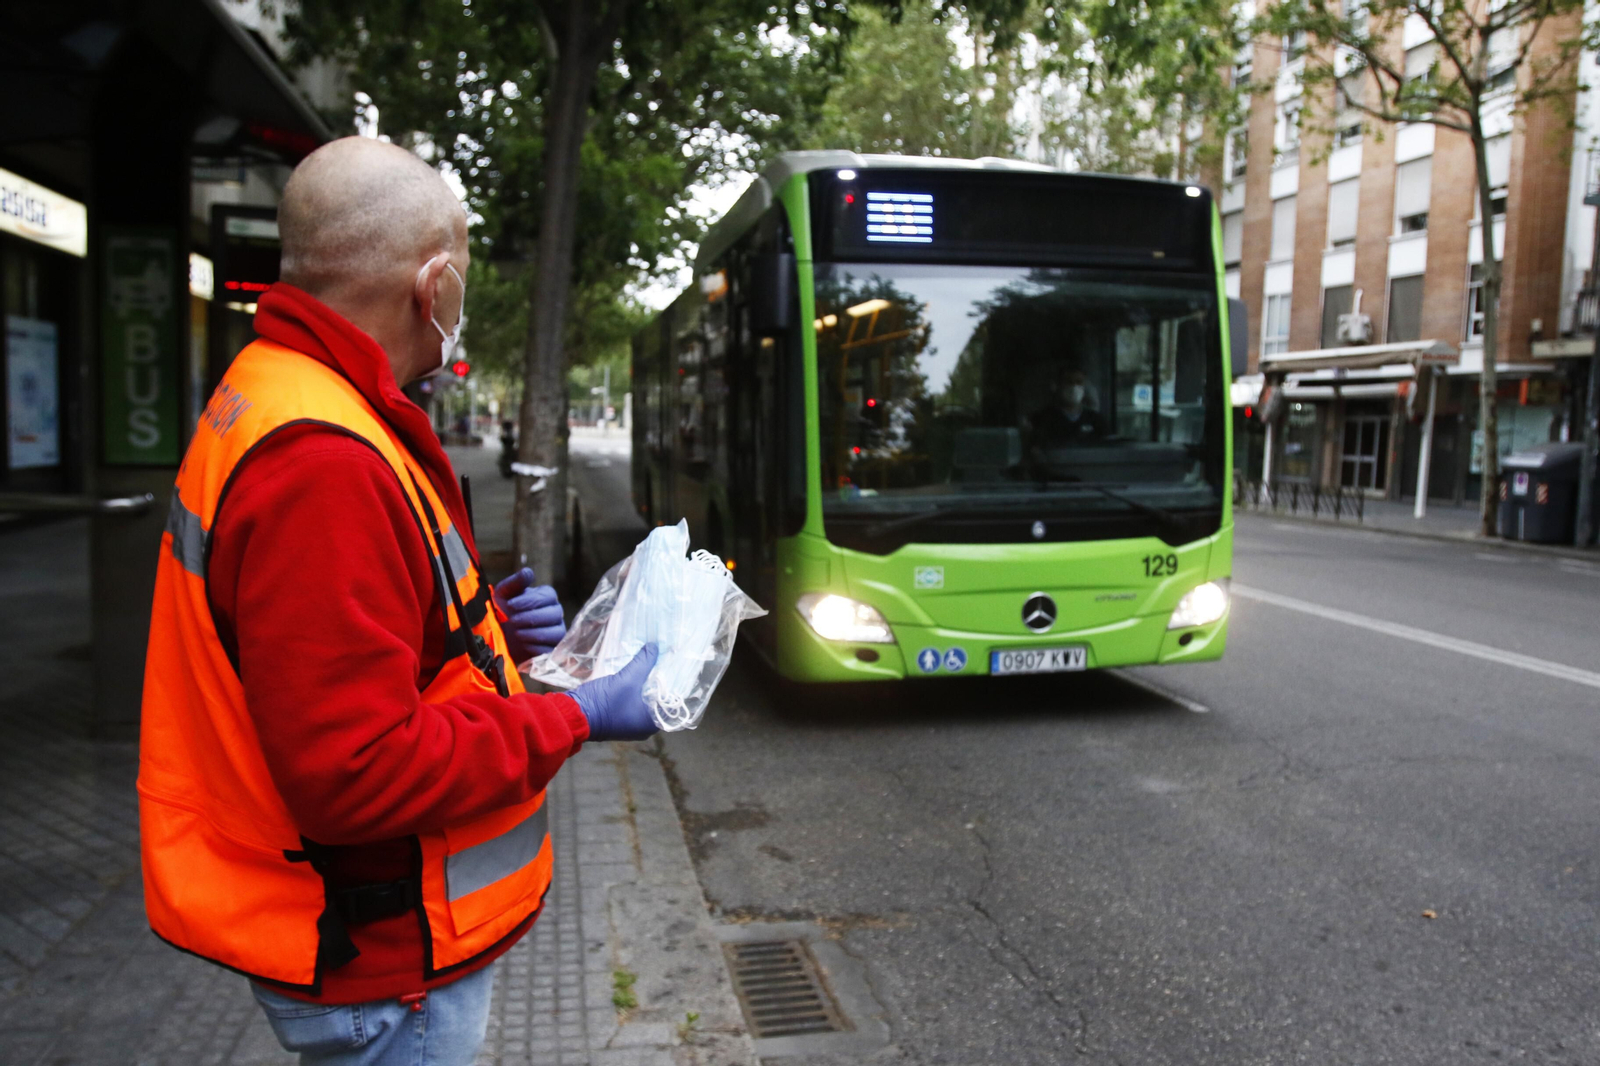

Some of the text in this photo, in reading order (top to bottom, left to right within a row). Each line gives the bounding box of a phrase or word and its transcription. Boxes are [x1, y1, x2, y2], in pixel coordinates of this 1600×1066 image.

[126, 323, 160, 447] BUS
[1142, 553, 1179, 577] 129
[1003, 649, 1082, 670] 0907 KWV
